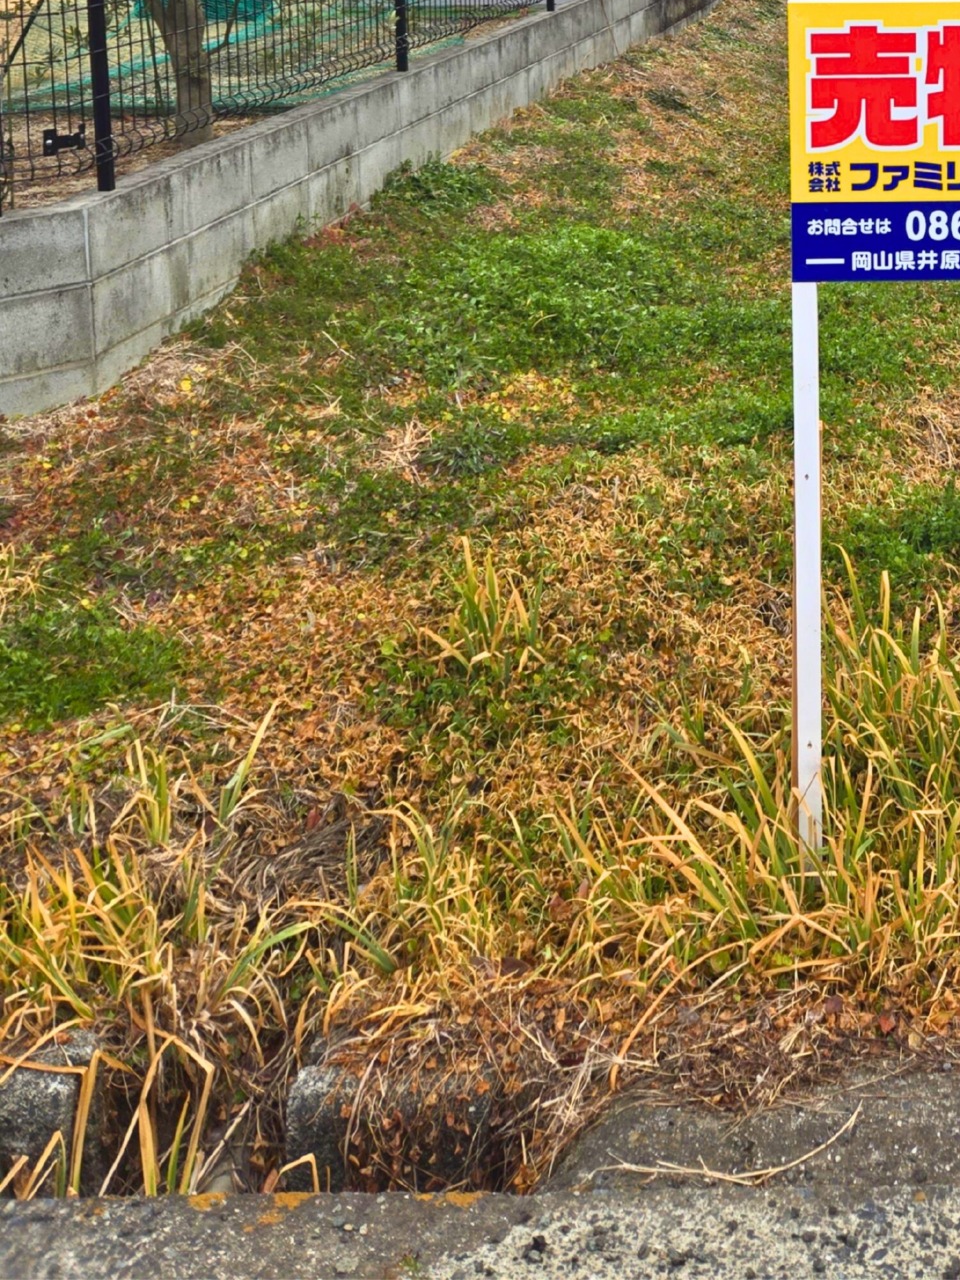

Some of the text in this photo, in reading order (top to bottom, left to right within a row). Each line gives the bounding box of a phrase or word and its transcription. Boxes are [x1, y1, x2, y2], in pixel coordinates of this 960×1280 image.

[807, 217, 892, 236] お問合せは
